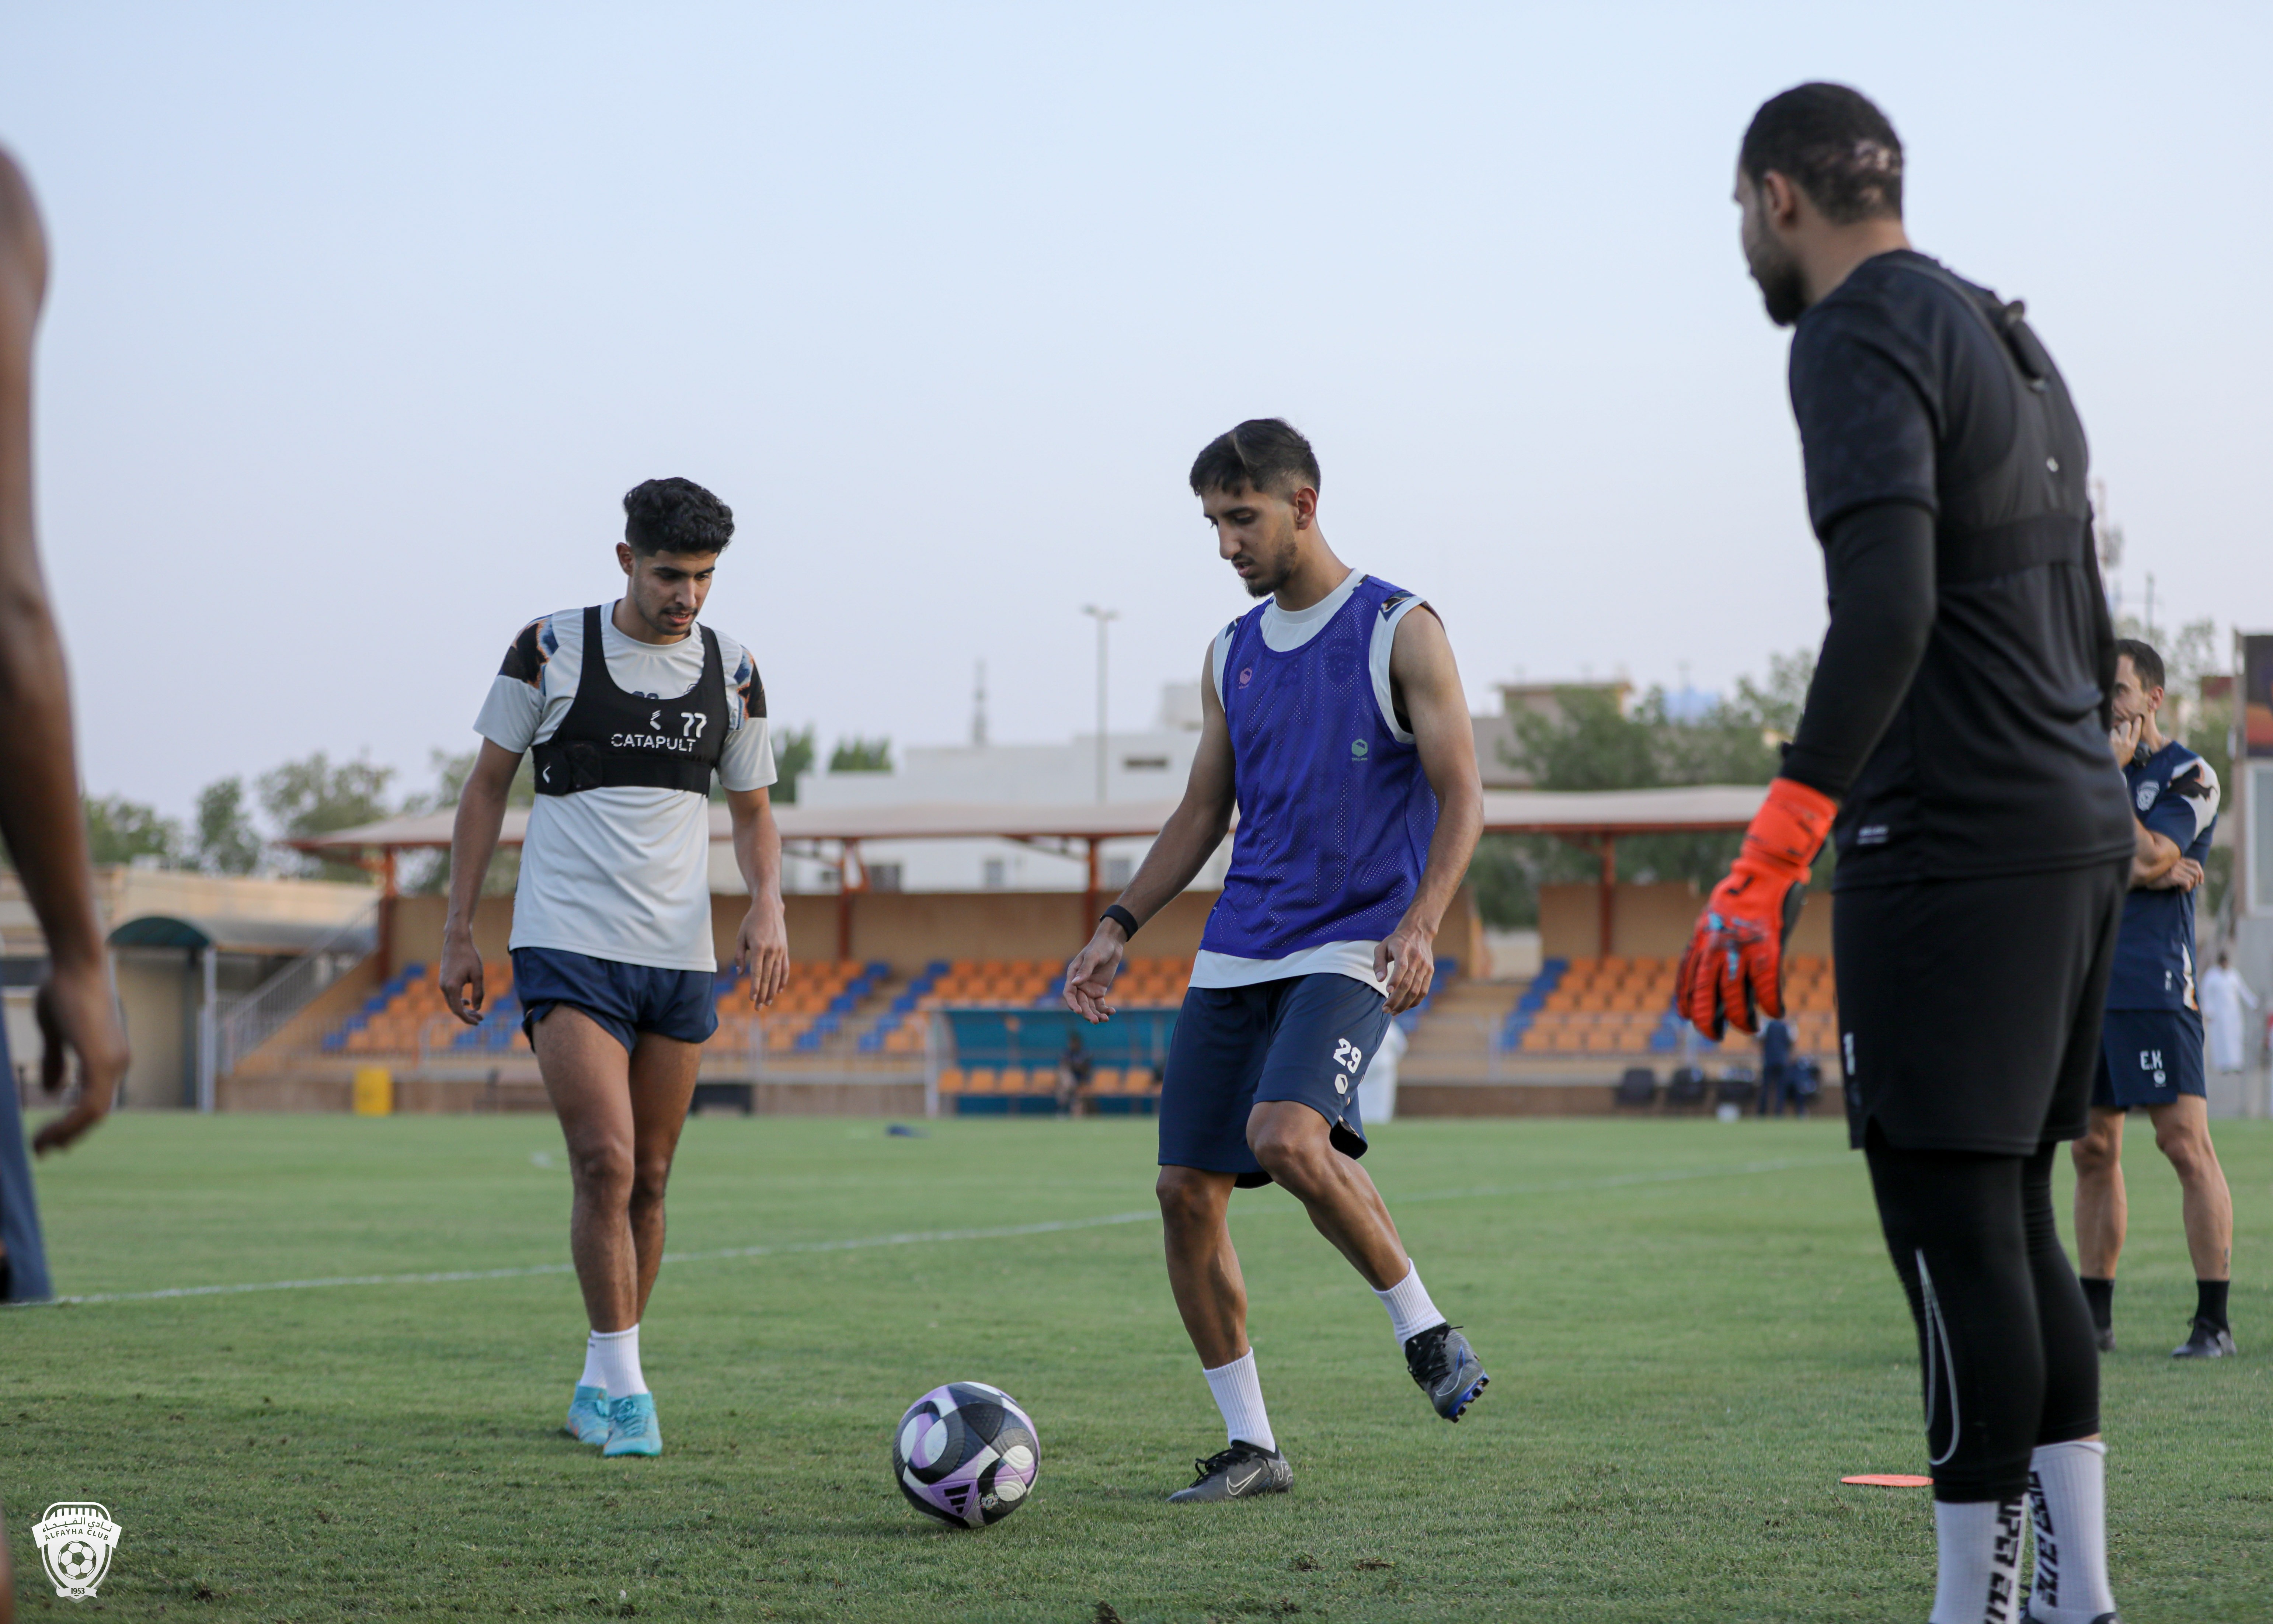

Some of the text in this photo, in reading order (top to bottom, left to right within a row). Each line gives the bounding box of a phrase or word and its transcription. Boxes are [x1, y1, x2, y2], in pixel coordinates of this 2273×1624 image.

[681, 712, 707, 738] 77
[611, 734, 696, 752] CATAPULT
[1333, 1038, 1362, 1074] 29
[1984, 1499, 2023, 1624] UPER ELI
